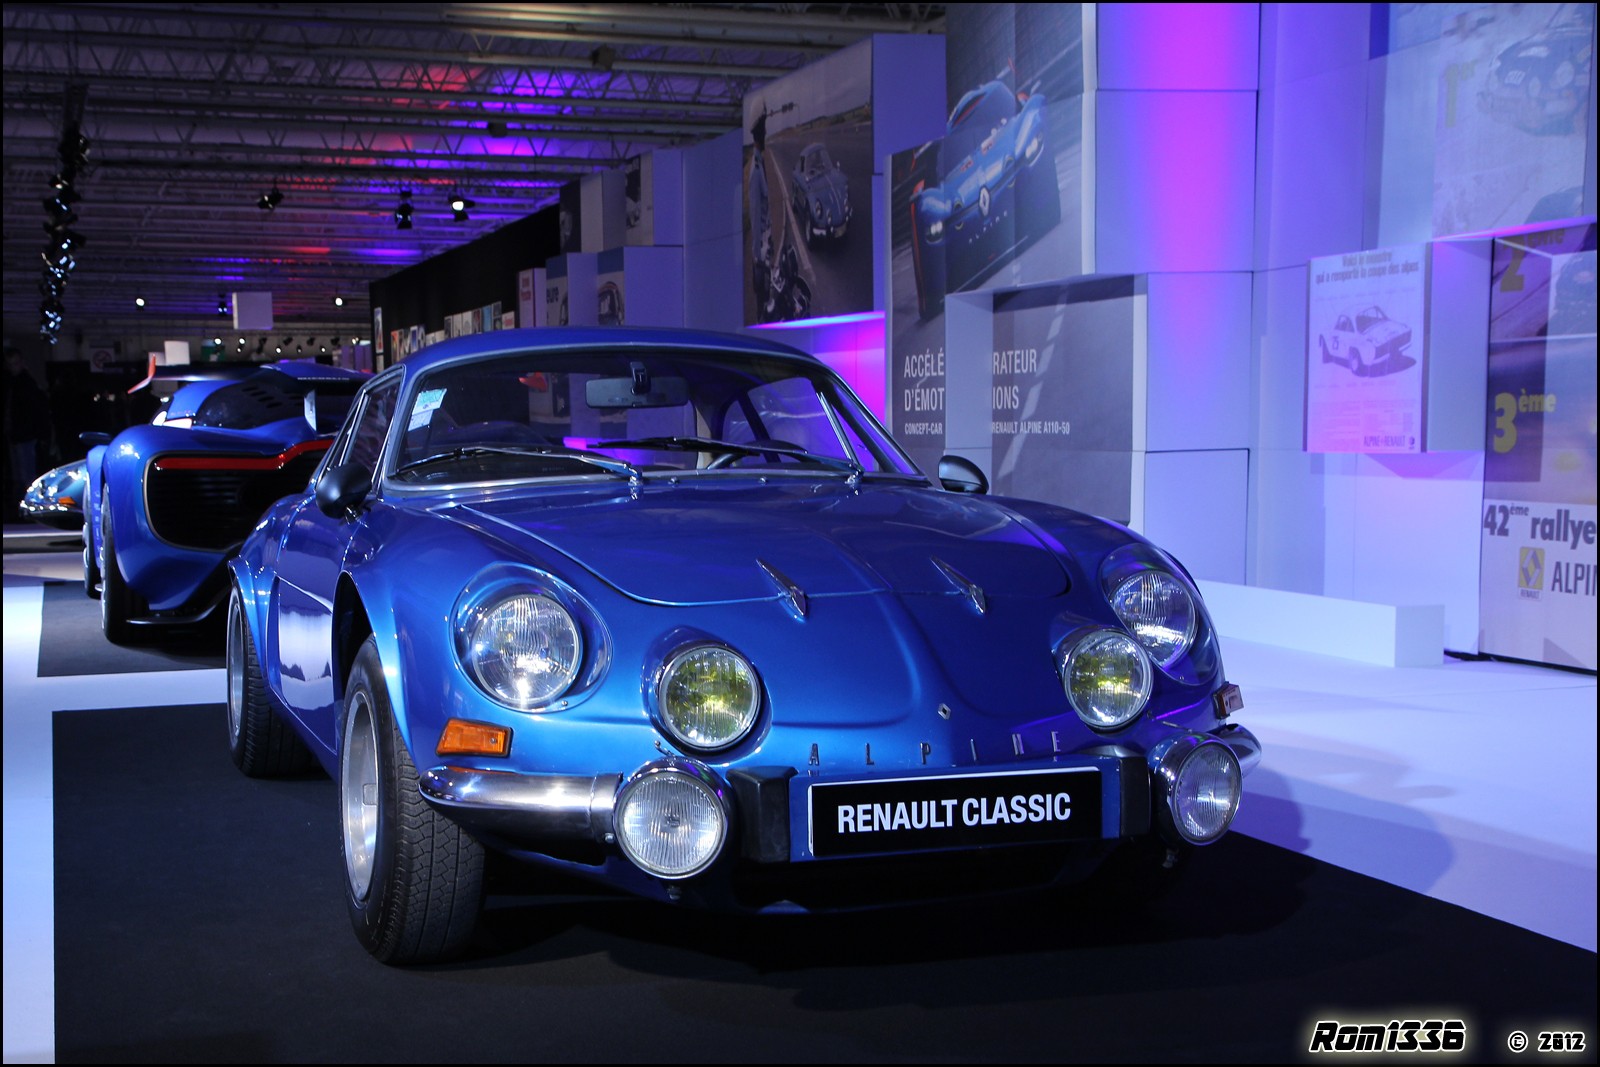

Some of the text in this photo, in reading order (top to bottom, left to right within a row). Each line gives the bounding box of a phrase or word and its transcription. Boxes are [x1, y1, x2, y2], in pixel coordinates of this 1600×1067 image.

[904, 348, 1037, 378] ACCÉLÉ RATEUR
[904, 381, 1020, 412] D'ÉMOT IONS
[904, 421, 1071, 435] CONCEPT-CAR RENAULT ALPINE A110-50
[1494, 388, 1556, 453] 3ème
[1530, 509, 1597, 550] rallye
[808, 730, 1062, 766] ALPINE
[837, 792, 1072, 834] RENAULT CLASSIC
